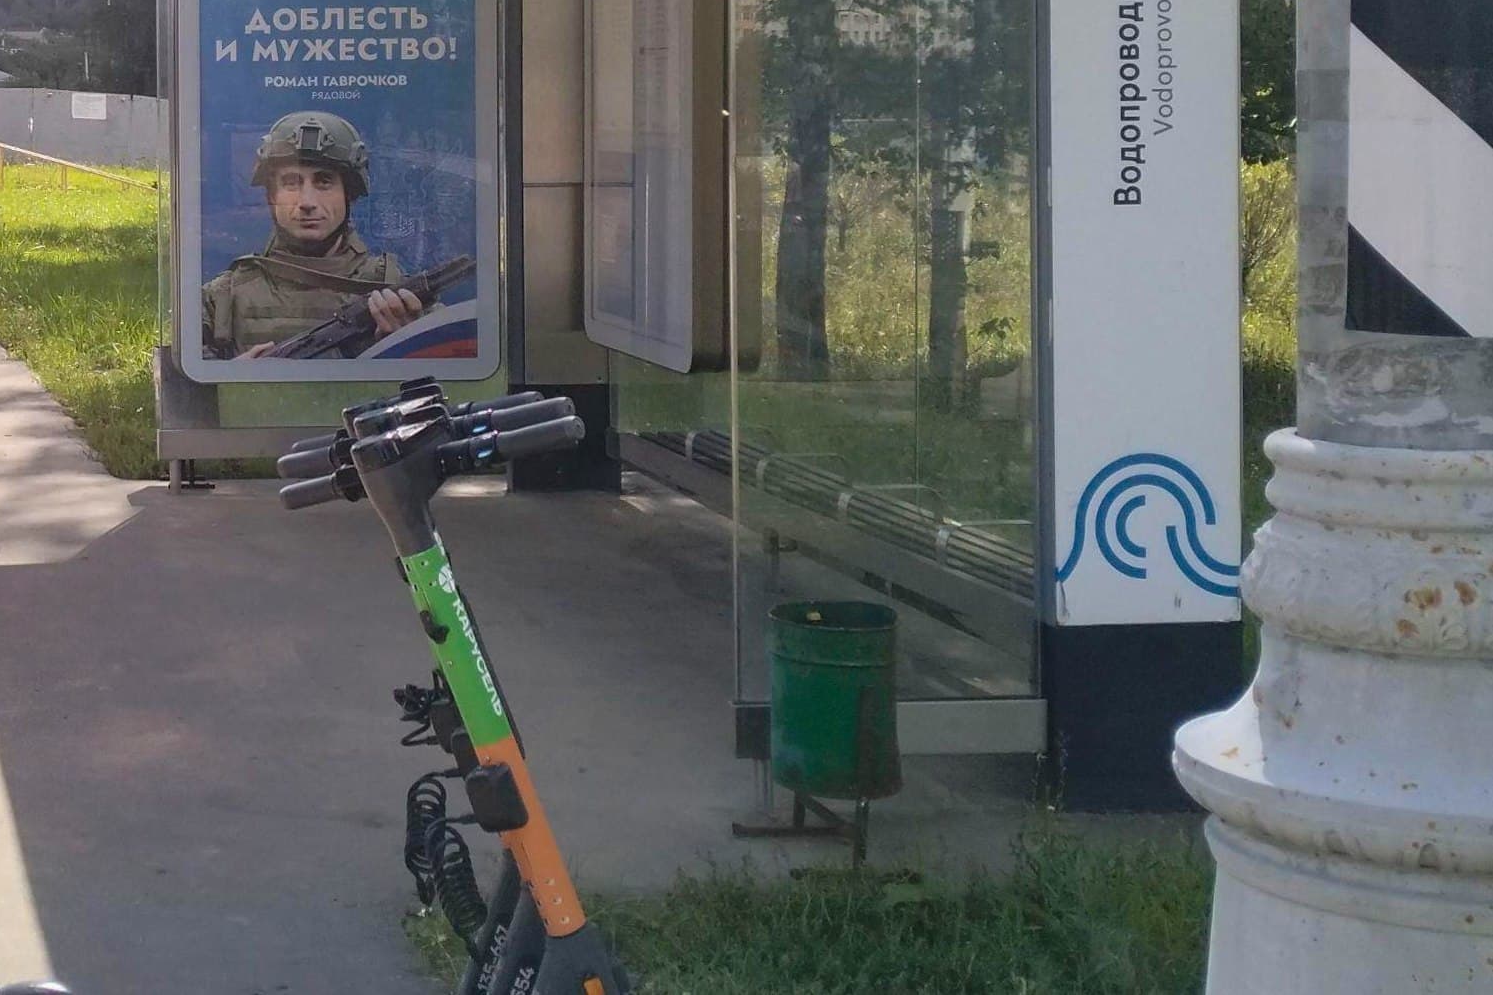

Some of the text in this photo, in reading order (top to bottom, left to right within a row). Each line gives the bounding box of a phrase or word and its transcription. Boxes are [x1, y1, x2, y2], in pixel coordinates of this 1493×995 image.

[244, 6, 429, 35] ДОБЛЕСТЬ
[215, 36, 458, 62] И МУЖЕСТВО!
[264, 74, 408, 88] РОМАН ГАВРОЧКОВ
[310, 90, 361, 101] РЯДОВОЙ
[452, 596, 503, 717] КАРУСЕЛЬ
